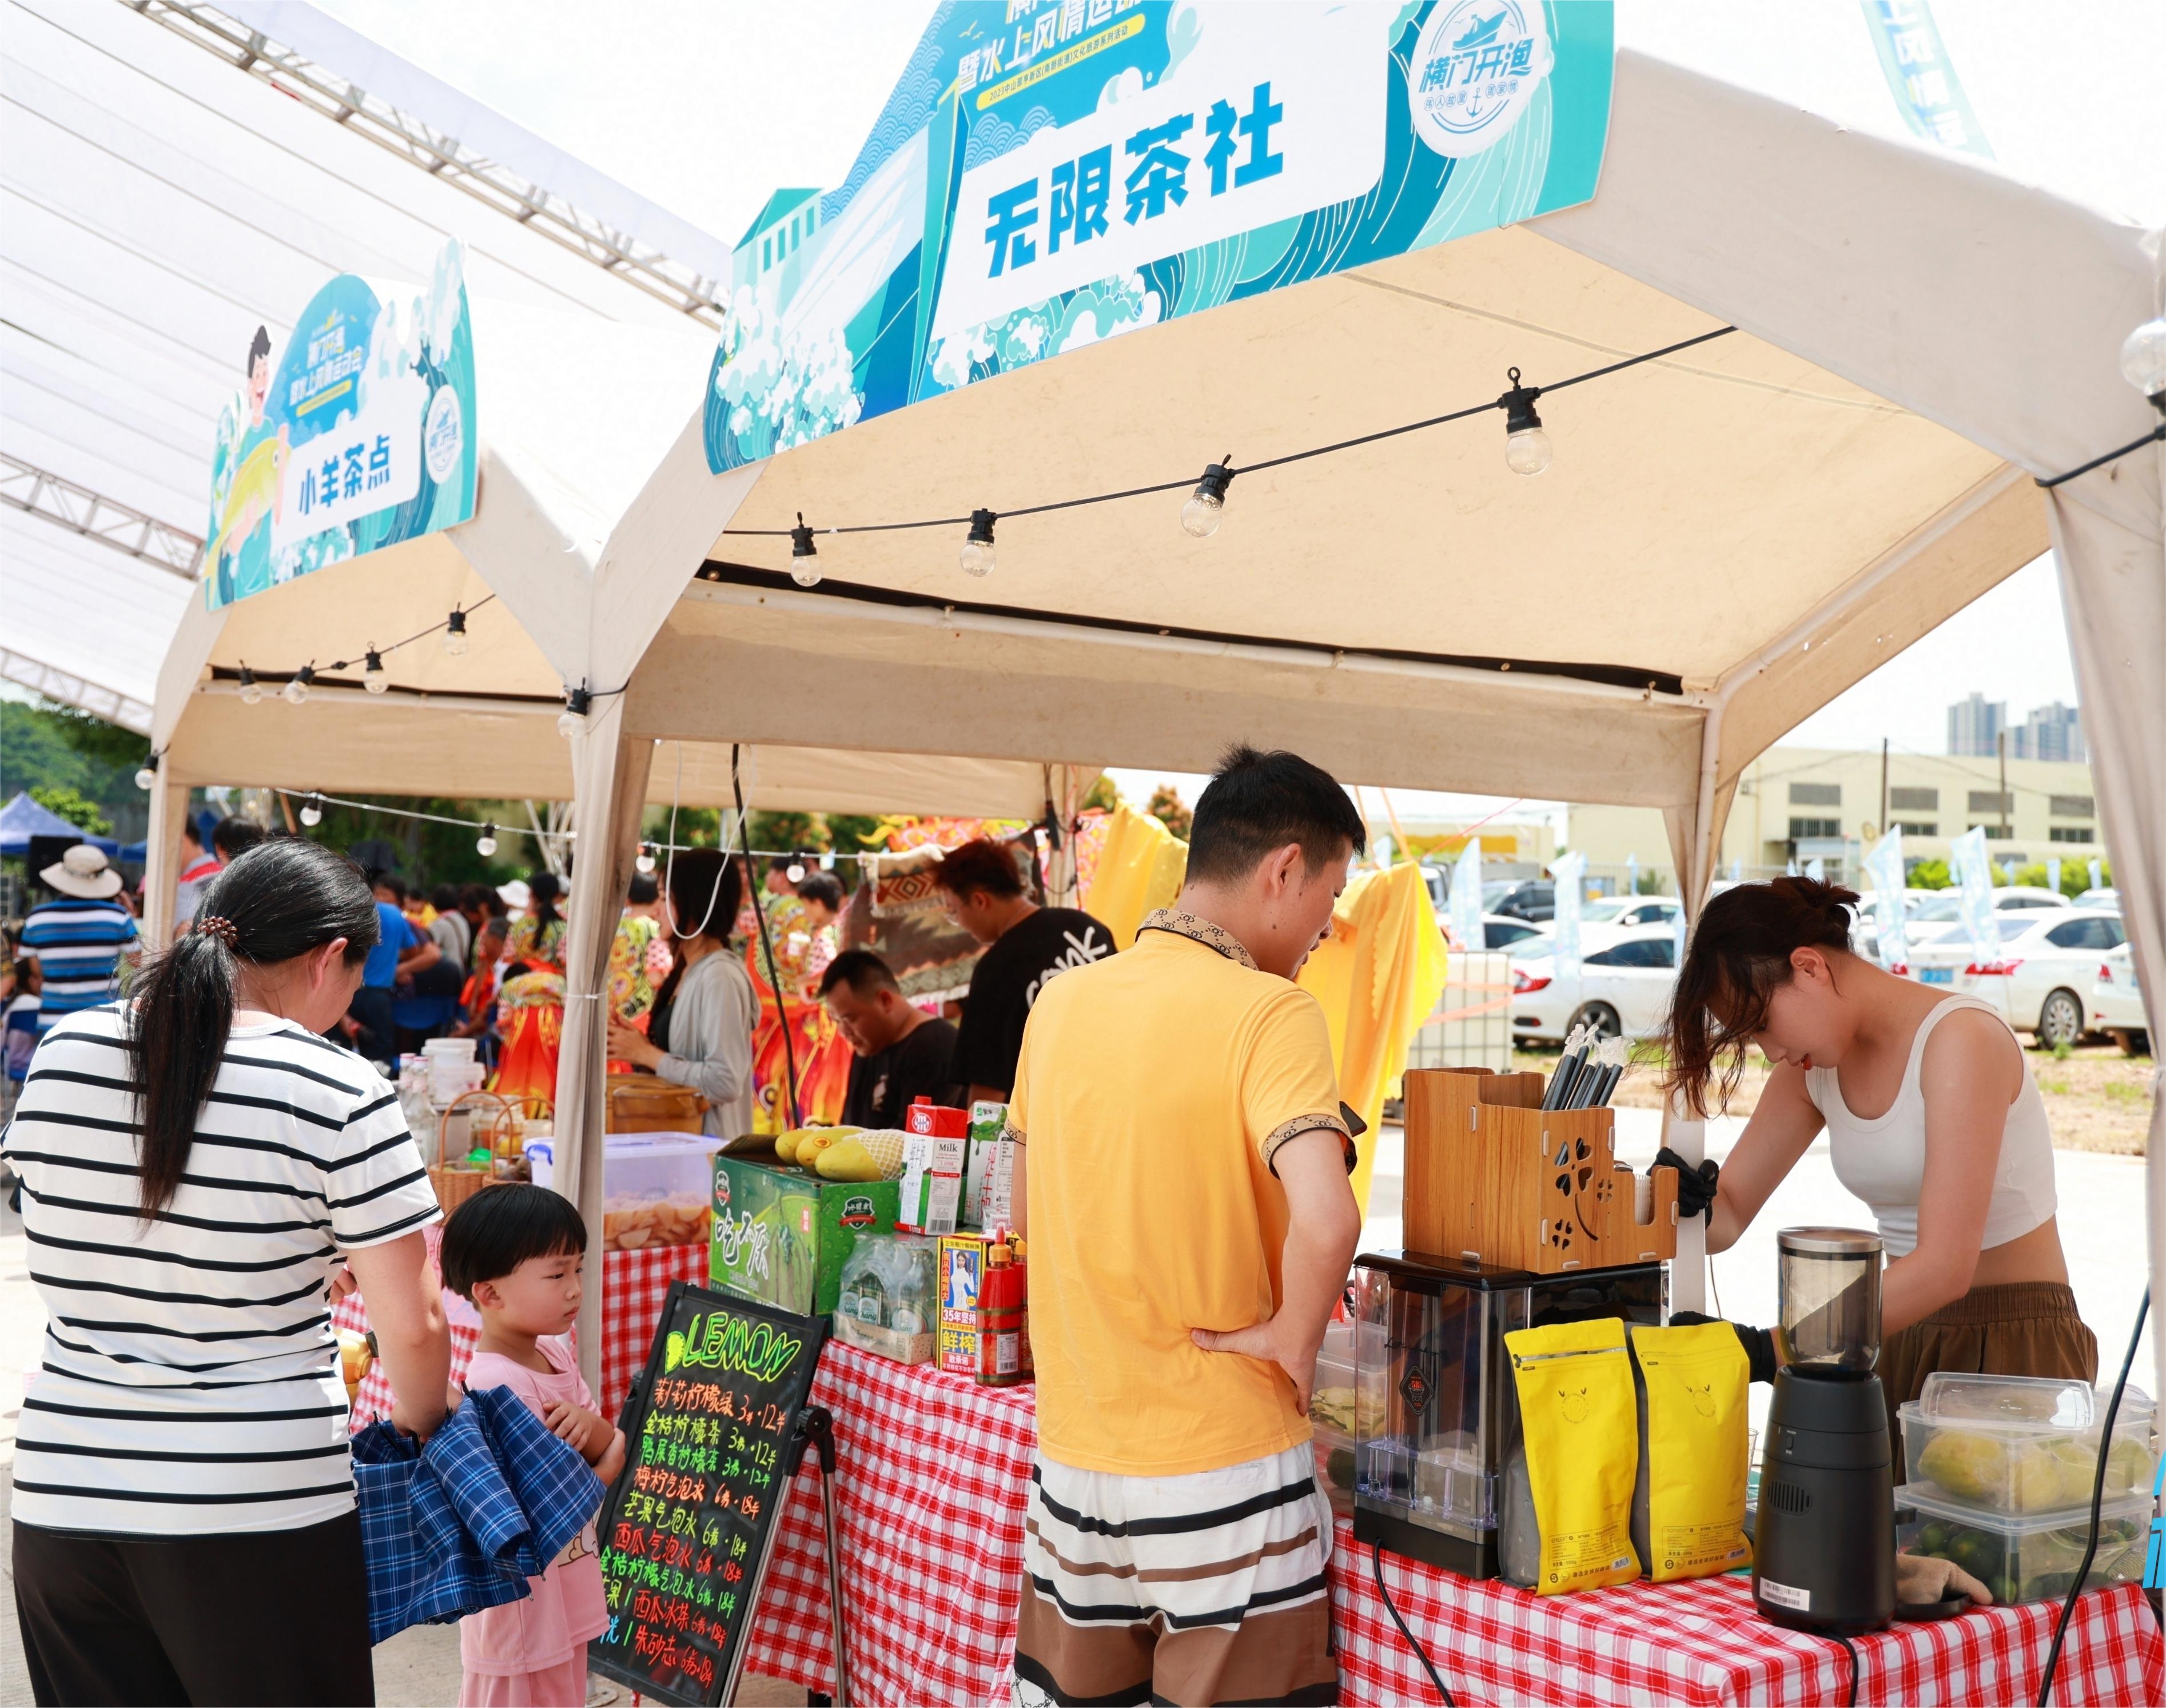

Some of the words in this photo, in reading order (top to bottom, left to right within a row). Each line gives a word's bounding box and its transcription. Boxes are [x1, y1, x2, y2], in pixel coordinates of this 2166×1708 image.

[1419, 38, 1535, 93] 横门开渔
[984, 81, 1284, 279] 无限茶社
[299, 435, 389, 515] 小羊茶点
[939, 1143, 958, 1152] Milk
[682, 1312, 802, 1383] LEMON
[624, 1489, 698, 1539] 芒果气泡水
[613, 1523, 694, 1568] 西瓜气泡水
